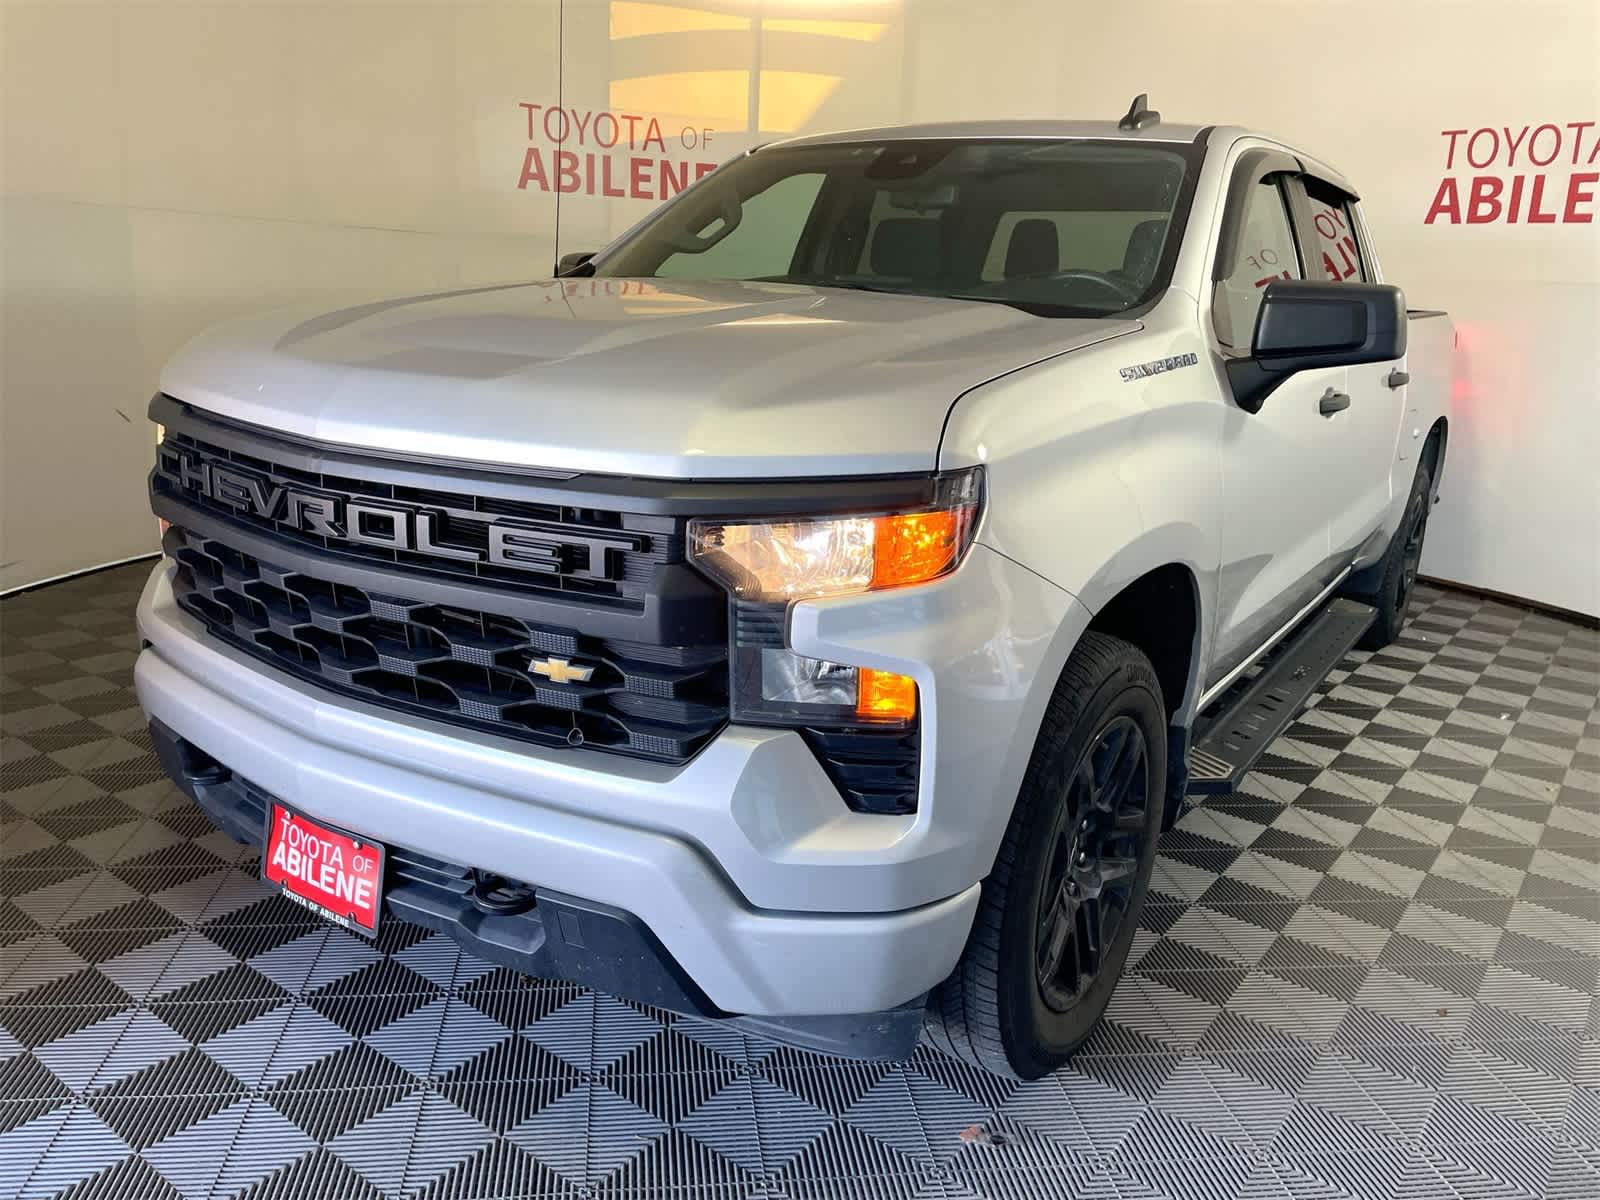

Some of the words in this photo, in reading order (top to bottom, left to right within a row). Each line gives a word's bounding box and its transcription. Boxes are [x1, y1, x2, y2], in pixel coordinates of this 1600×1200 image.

[519, 102, 667, 153] TOYOTA
[680, 125, 715, 151] OF
[159, 448, 654, 582] CHEVROLET
[280, 817, 344, 870] TOYOTA
[352, 854, 375, 874] OF
[272, 840, 374, 911] ABILENE
[281, 887, 307, 908] TOYOTA
[308, 901, 319, 912] OF
[319, 907, 350, 928] ABILENE
